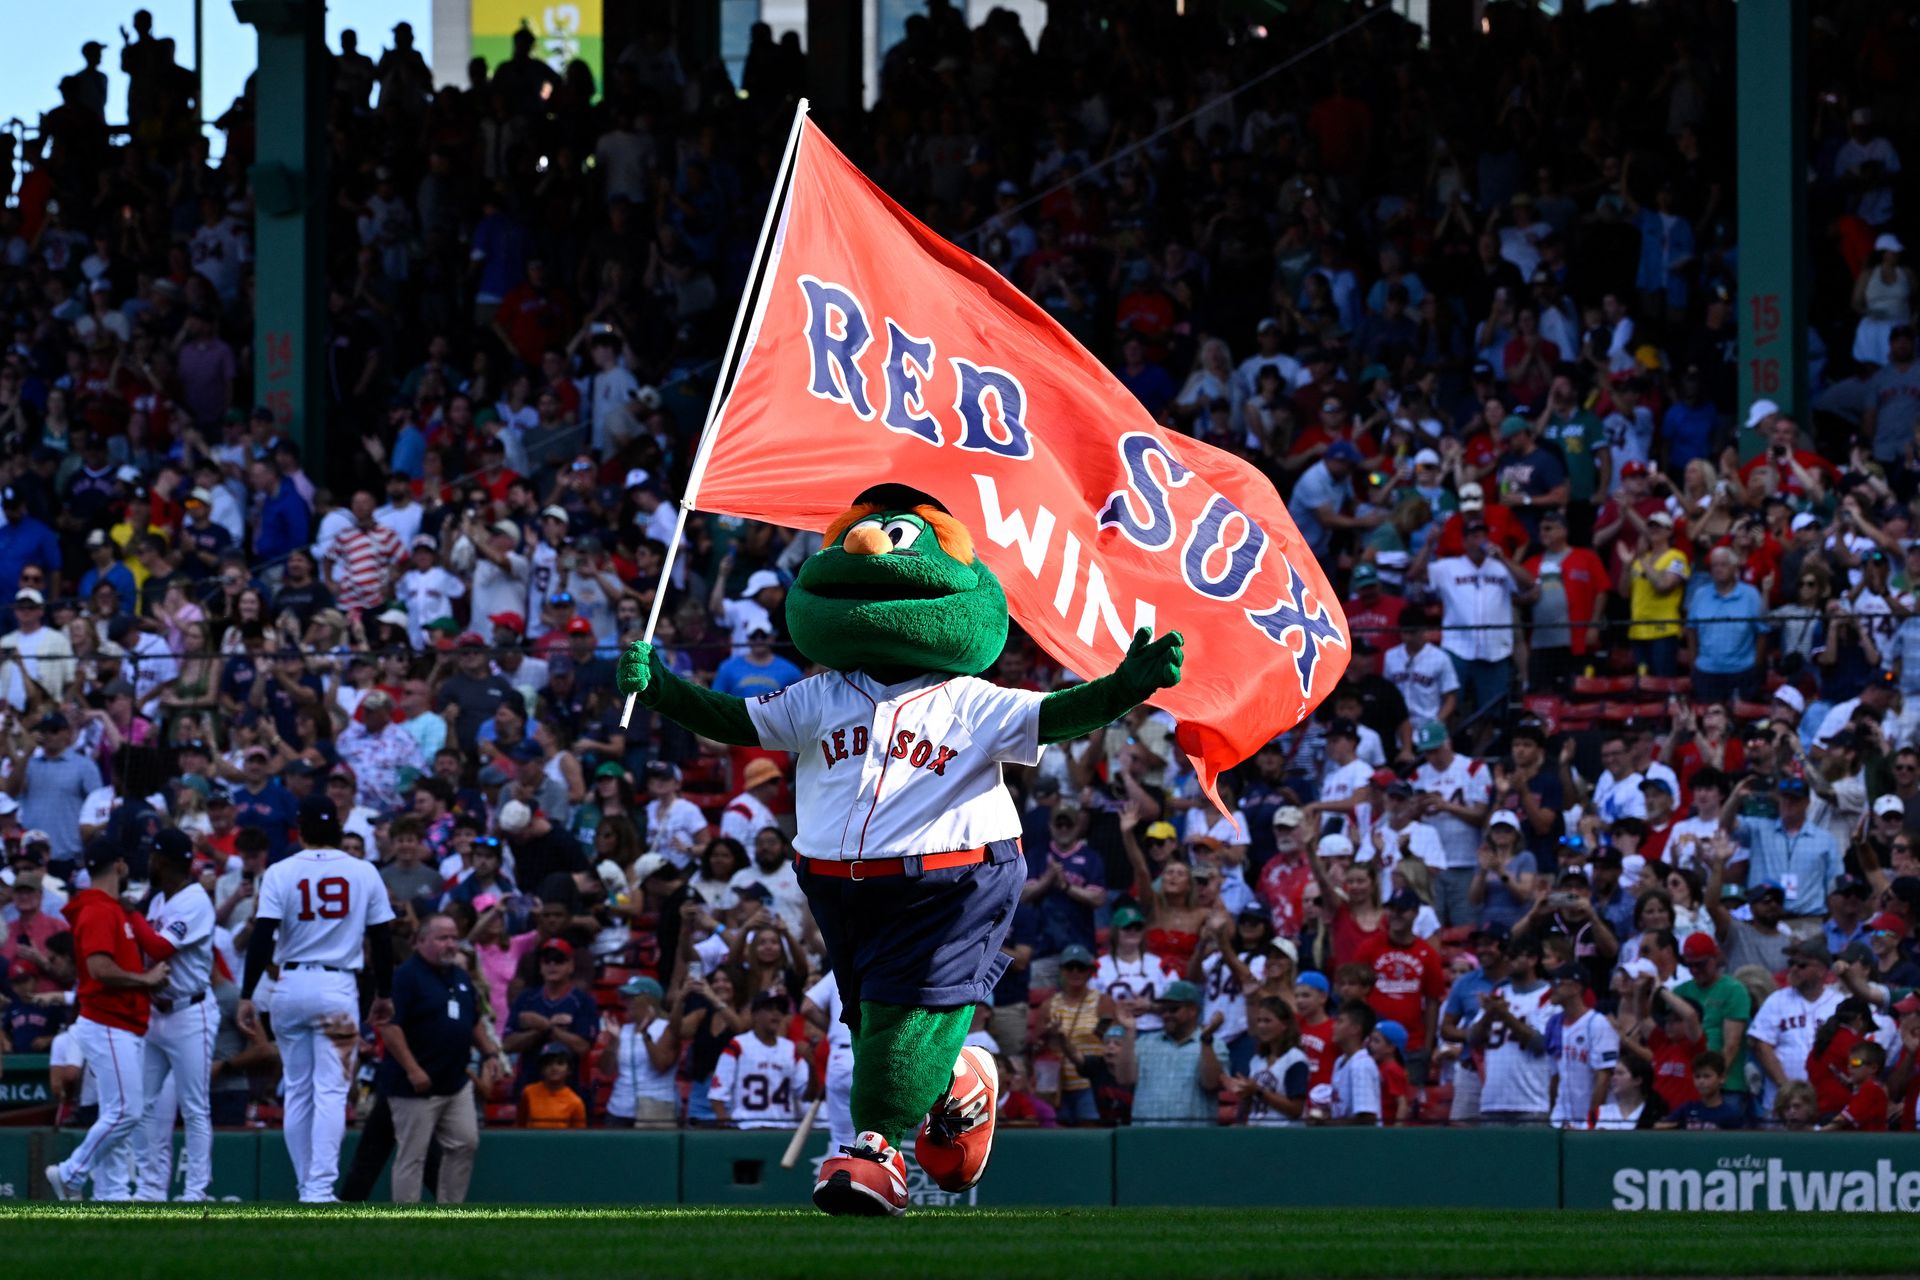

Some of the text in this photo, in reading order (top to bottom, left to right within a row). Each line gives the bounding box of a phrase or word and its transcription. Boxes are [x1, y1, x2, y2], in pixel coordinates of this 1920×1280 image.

[1750, 295, 1780, 331] 15
[266, 331, 293, 366] 14
[1750, 358, 1780, 394] 16
[797, 274, 1346, 698] RED SOX
[971, 473, 1155, 653] WIN
[891, 729, 958, 775] SOX
[297, 876, 349, 921] 19
[742, 1074, 792, 1113] 34
